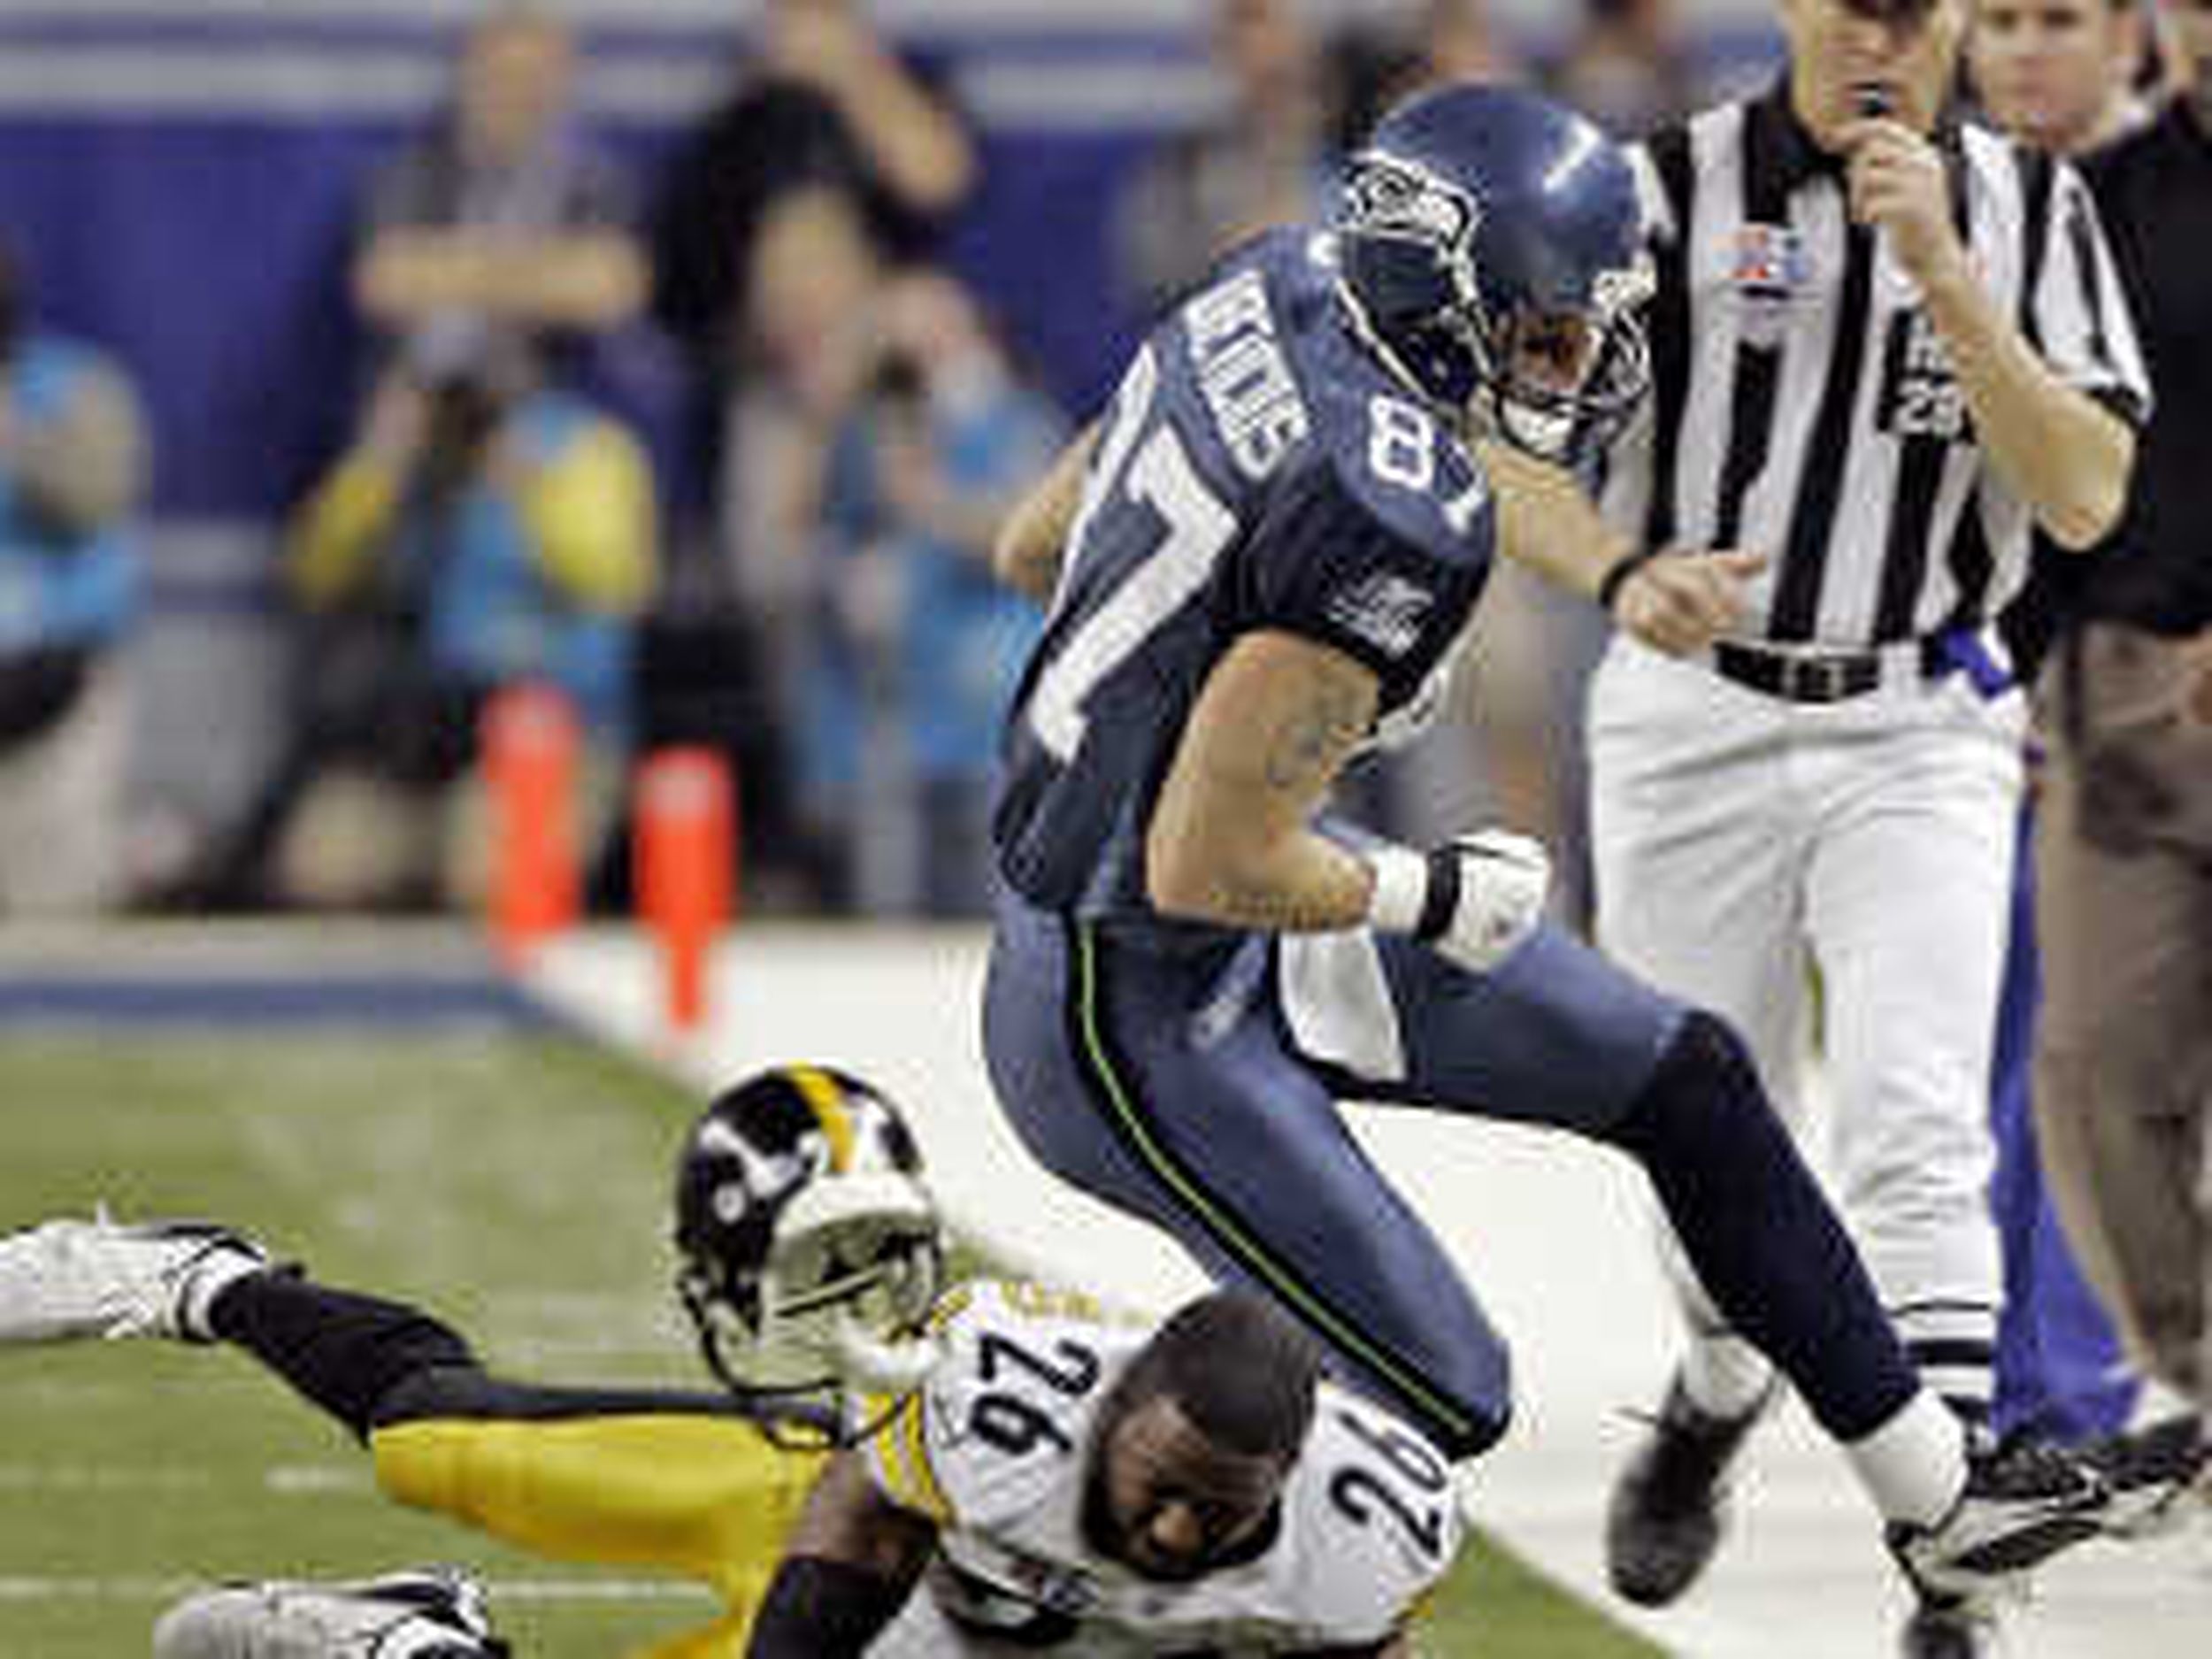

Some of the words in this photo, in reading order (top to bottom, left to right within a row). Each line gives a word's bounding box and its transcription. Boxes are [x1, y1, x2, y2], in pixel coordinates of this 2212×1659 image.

[1367, 394, 1488, 534] 87
[968, 1333, 1102, 1454] 26
[1330, 1409, 1452, 1562] 26
